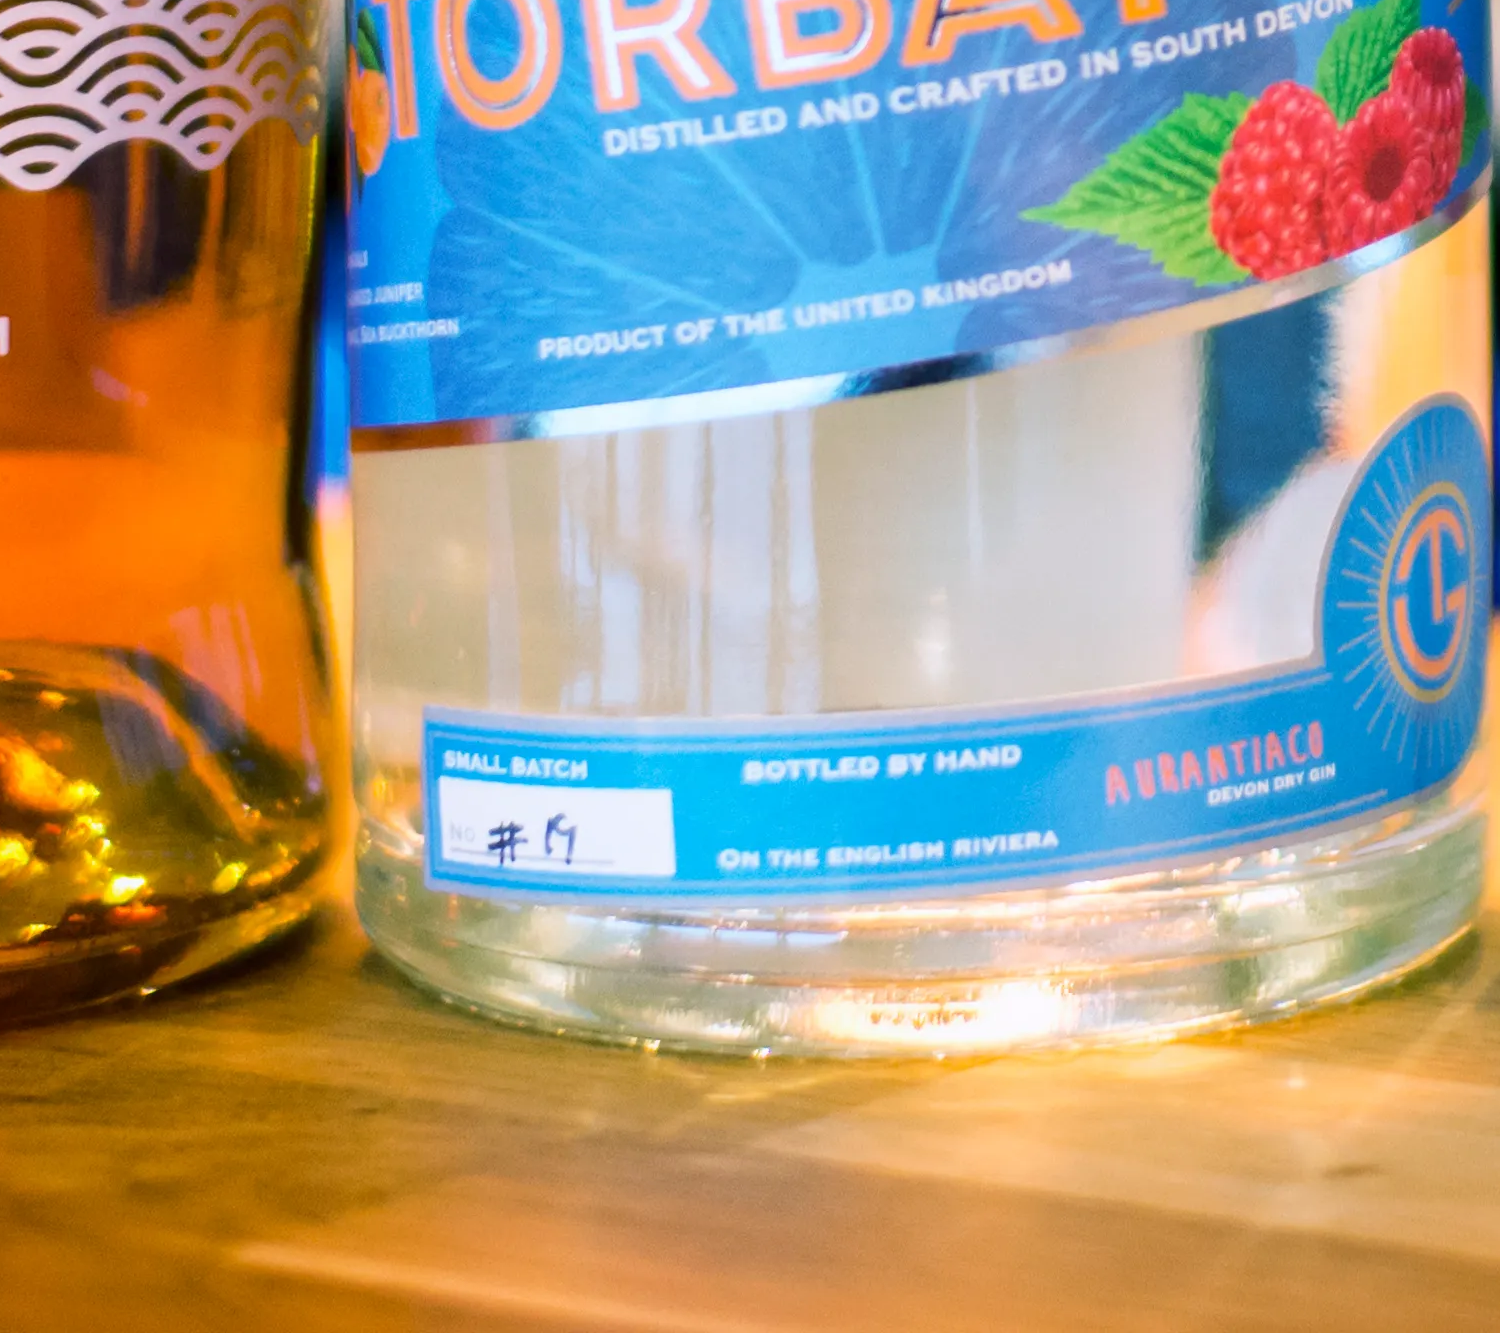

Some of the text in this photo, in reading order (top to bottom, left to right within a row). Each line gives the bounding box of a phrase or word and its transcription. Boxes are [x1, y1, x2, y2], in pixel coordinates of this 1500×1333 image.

[605, 106, 786, 156] DISTILLED
[798, 91, 879, 130] AND
[889, 57, 1066, 115] CRAFTED
[1080, 48, 1120, 79] IN
[1131, 17, 1247, 67] SOUTH
[539, 261, 1071, 361] PRODUCT OF THE UNITED KINGDOM
[444, 750, 588, 780] SMALL BATCH
[741, 745, 1022, 783] BOTTLED BY HAND
[1106, 721, 1325, 806] AURANTIACO
[1207, 763, 1337, 807] DEVON DRY GIN
[768, 846, 819, 868] THE
[827, 840, 944, 867] ENGLISH
[952, 830, 1059, 859] RIVIERA
